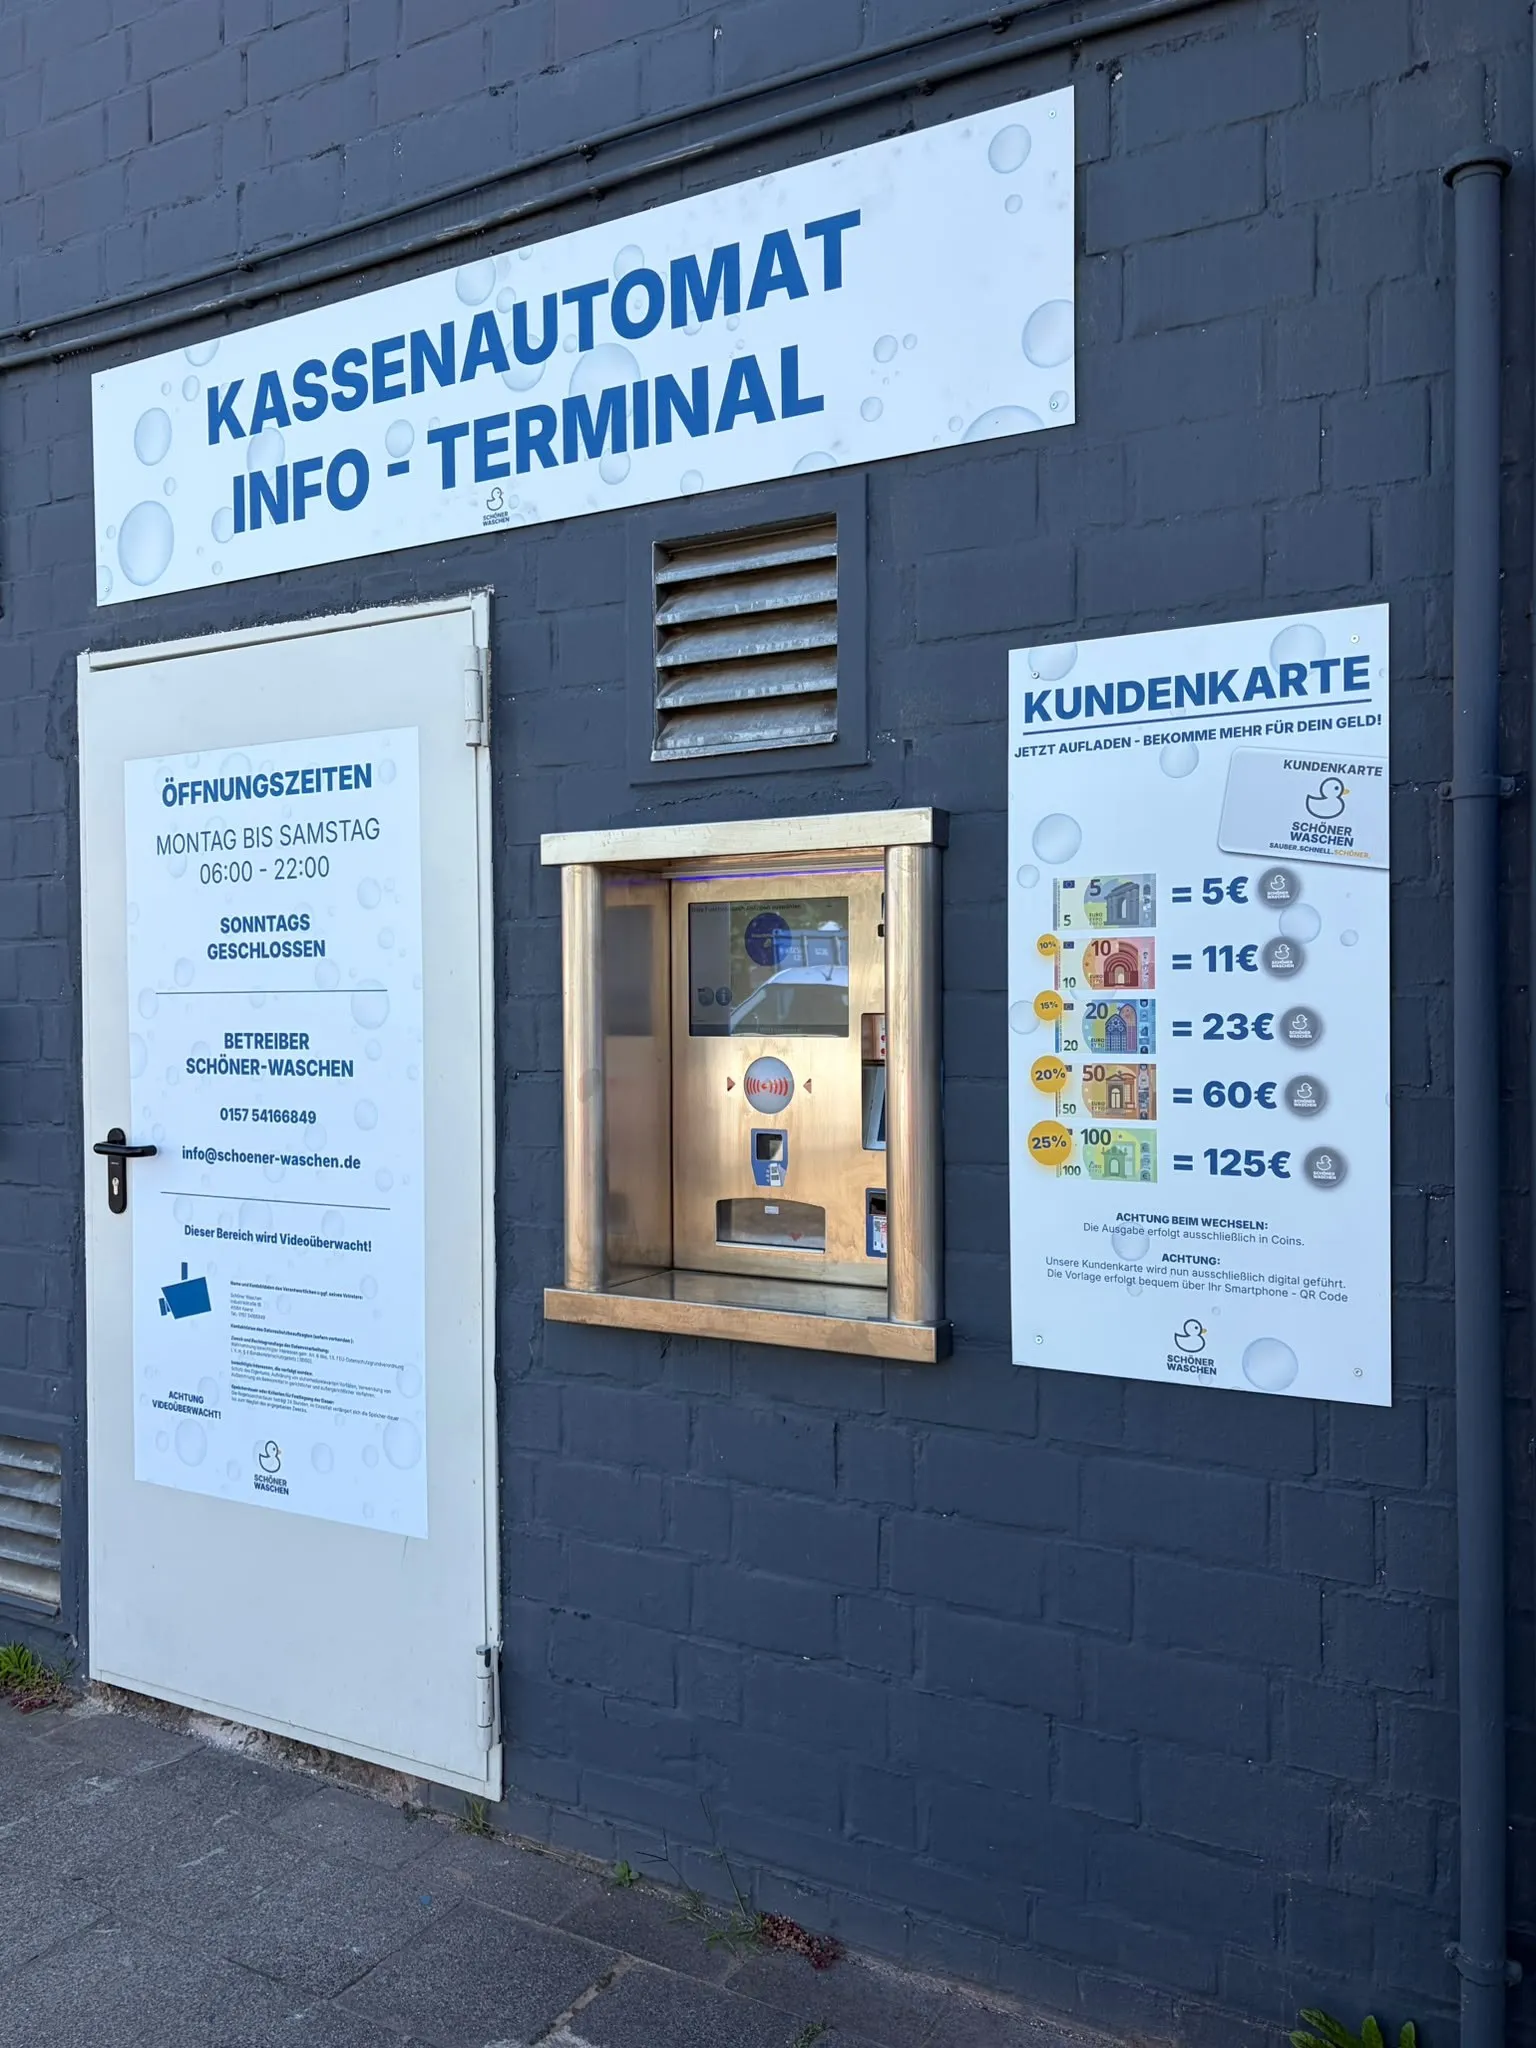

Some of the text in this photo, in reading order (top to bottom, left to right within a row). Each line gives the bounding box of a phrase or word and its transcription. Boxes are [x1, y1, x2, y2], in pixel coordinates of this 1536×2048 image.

[207, 208, 862, 446] KASSENAUTOMAT
[231, 344, 825, 535] INFO - TERMINAL
[483, 511, 508, 521] SCHÖNER
[483, 517, 510, 526] WASCHEN
[1023, 655, 1371, 725] KUNDENKARTE
[1014, 743, 1056, 758] JETZT
[1058, 736, 1132, 754] AUFLADEN
[1143, 728, 1216, 747] BEKOMME
[1219, 724, 1262, 740] MEHR
[1265, 719, 1294, 736] FÜR
[1297, 718, 1333, 733] DEIN
[1336, 714, 1382, 729] GELD!
[1283, 759, 1383, 776] KUNDENKARTE
[162, 763, 372, 808] ÖFFNUNGSZEITEN
[156, 817, 381, 856] MONTAG BIS SAMSTAG
[1291, 821, 1352, 837] SCHÖNER
[1290, 831, 1354, 847] WASCHEN
[200, 861, 253, 885] 06:00
[274, 855, 330, 880] 22:00
[1090, 879, 1102, 896] 5
[1172, 876, 1249, 905] = 5€
[220, 913, 310, 934] SONNTAGS
[1063, 914, 1072, 926] 5
[207, 939, 326, 960] GESCHLOSSEN
[1039, 941, 1057, 949] 10%
[1091, 940, 1112, 956] 10
[1172, 944, 1259, 972] = 11€
[1063, 977, 1076, 988] 10
[1040, 1001, 1058, 1010] 15%
[1085, 1002, 1108, 1020] 20
[1172, 1012, 1275, 1041] = 23€
[224, 1032, 310, 1051] BETREIBER
[1063, 1040, 1079, 1052] 20
[186, 1054, 354, 1078] SCHÖNER-WASCHEN
[1035, 1068, 1066, 1081] 20%
[1082, 1065, 1106, 1082] 50
[1172, 1081, 1278, 1110] = 60€
[220, 1107, 317, 1124] 0157 54166849
[1062, 1103, 1076, 1114] 50
[1031, 1135, 1067, 1150] 25%
[1080, 1128, 1112, 1145] 100
[182, 1146, 361, 1170] info@schoener-waschen.de
[1173, 1148, 1292, 1179] = 125€
[1062, 1165, 1082, 1176] 100
[1115, 1212, 1268, 1231] ACHTUNG BEIM WECHSELN:
[184, 1224, 372, 1253] Dieser Bereich wird Videoüberwacht!
[1083, 1222, 1305, 1247] Die Ausgabe erfolgt ausschließlich in Coins.
[1161, 1253, 1221, 1266] ACHTUNG:
[1045, 1256, 1346, 1290] Unsere Kundenkarte wird nun ausschließlich digital geführt.
[1047, 1268, 1063, 1279] Die
[1065, 1270, 1102, 1285] Vorlage
[1104, 1272, 1137, 1287] erfolgt
[1138, 1276, 1180, 1291] bequem
[1182, 1278, 1205, 1291] über
[1208, 1280, 1223, 1292] Ihr
[1225, 1282, 1289, 1299] Smartphone
[1300, 1288, 1316, 1301] QR
[1318, 1290, 1349, 1303] Code
[1166, 1354, 1215, 1367] SCHÖNER
[1166, 1362, 1217, 1375] WASCHEN
[168, 1390, 204, 1405] ACHTUNG
[152, 1399, 222, 1419] VIDEOÜBERWACHT!
[253, 1473, 287, 1487] SCHÖNER
[253, 1481, 289, 1496] WASCHEN
